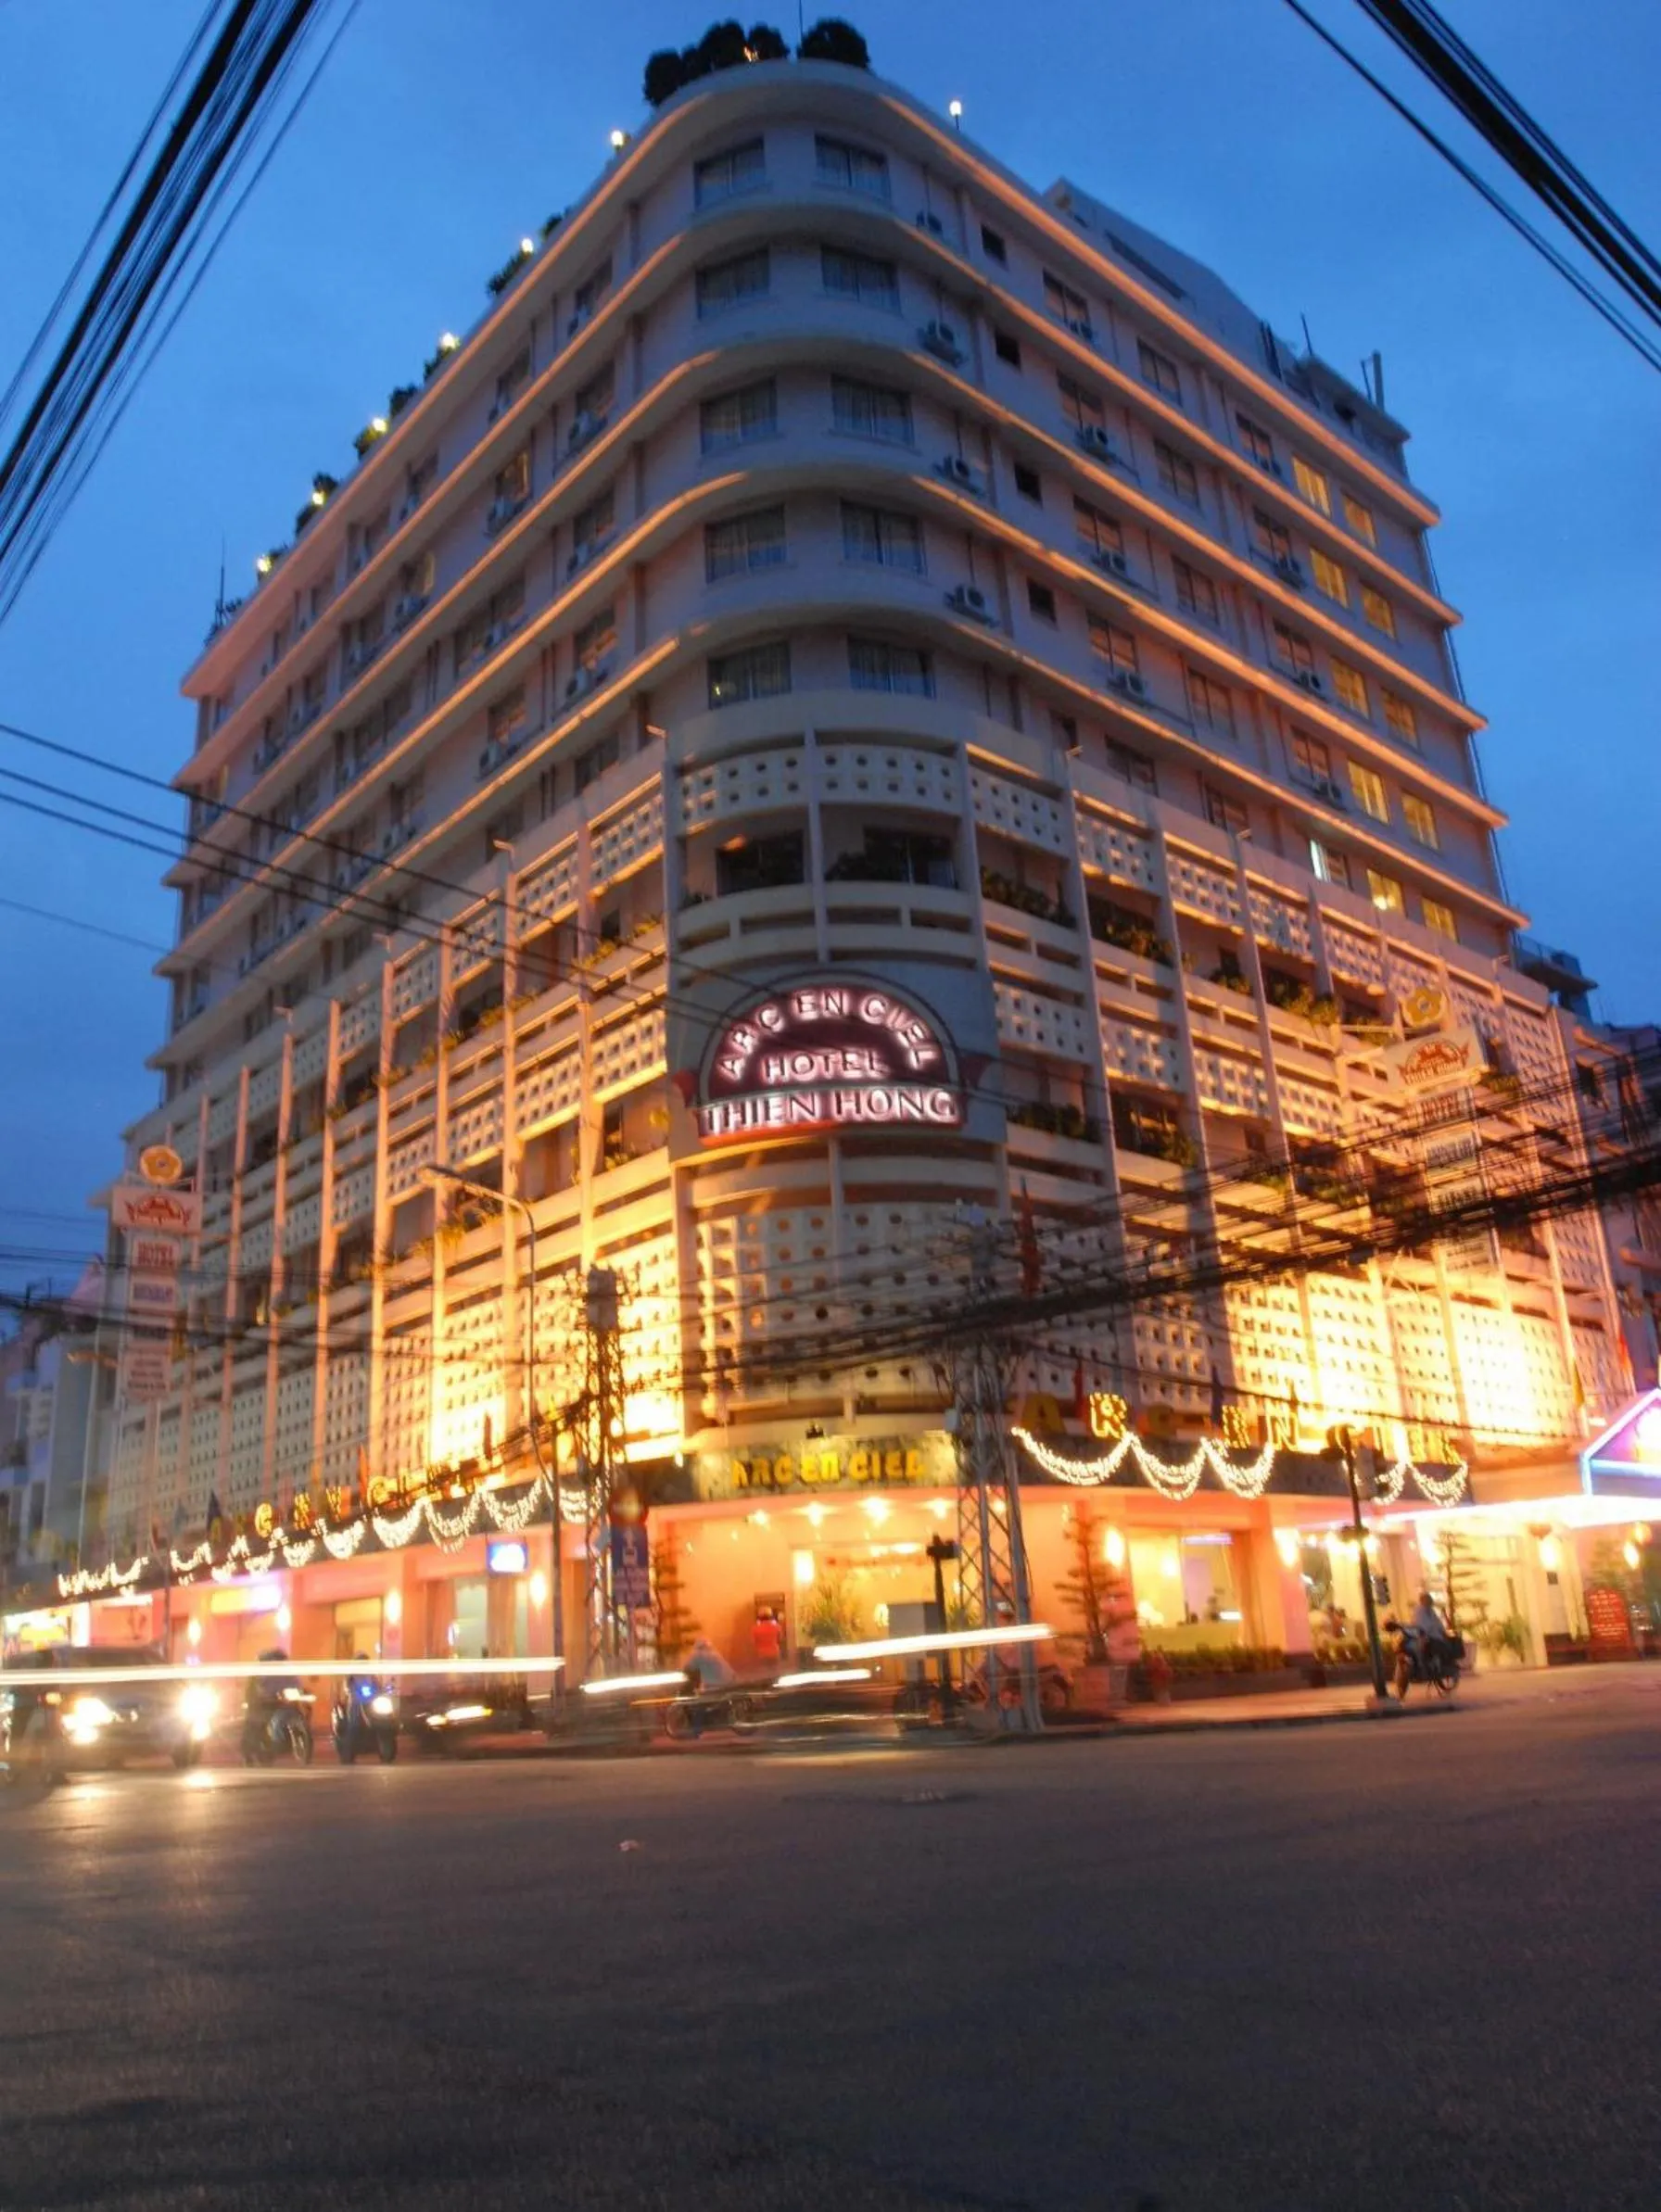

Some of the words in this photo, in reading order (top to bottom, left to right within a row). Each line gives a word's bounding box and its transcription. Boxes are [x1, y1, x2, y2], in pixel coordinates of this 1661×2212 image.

[717, 1003, 786, 1082] ARC
[794, 989, 850, 1021] EN
[859, 993, 938, 1070] CIEL
[762, 1050, 890, 1083] HOTEL
[702, 1092, 821, 1136] THIEN
[831, 1087, 960, 1123] HONG
